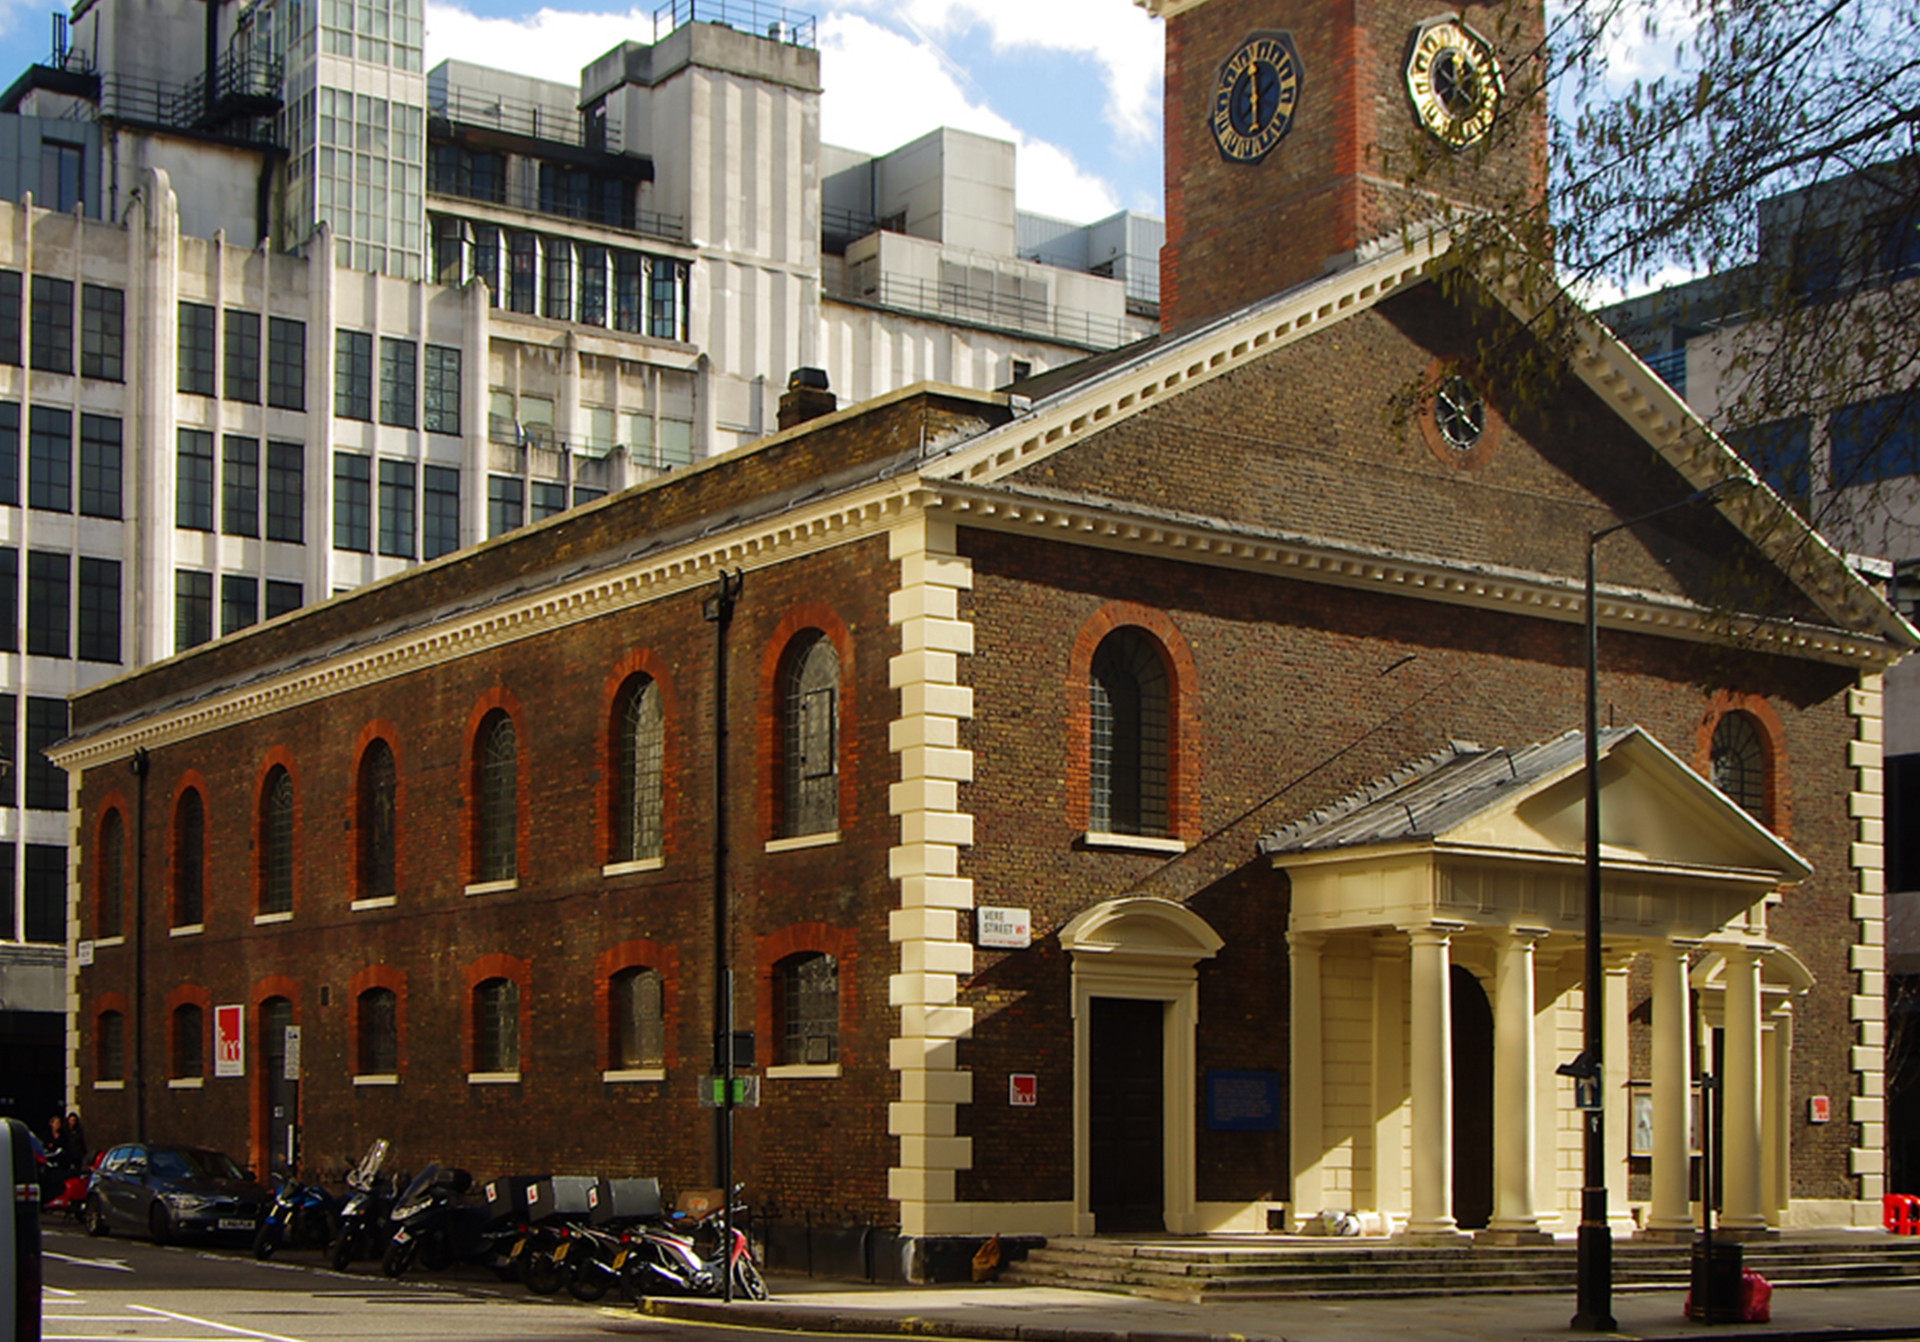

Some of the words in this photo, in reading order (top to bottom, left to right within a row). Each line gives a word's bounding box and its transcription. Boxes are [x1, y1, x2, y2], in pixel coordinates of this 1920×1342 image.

[983, 910, 1004, 922] VERE
[984, 923, 1013, 934] STREET
[1014, 925, 1027, 934] W1
